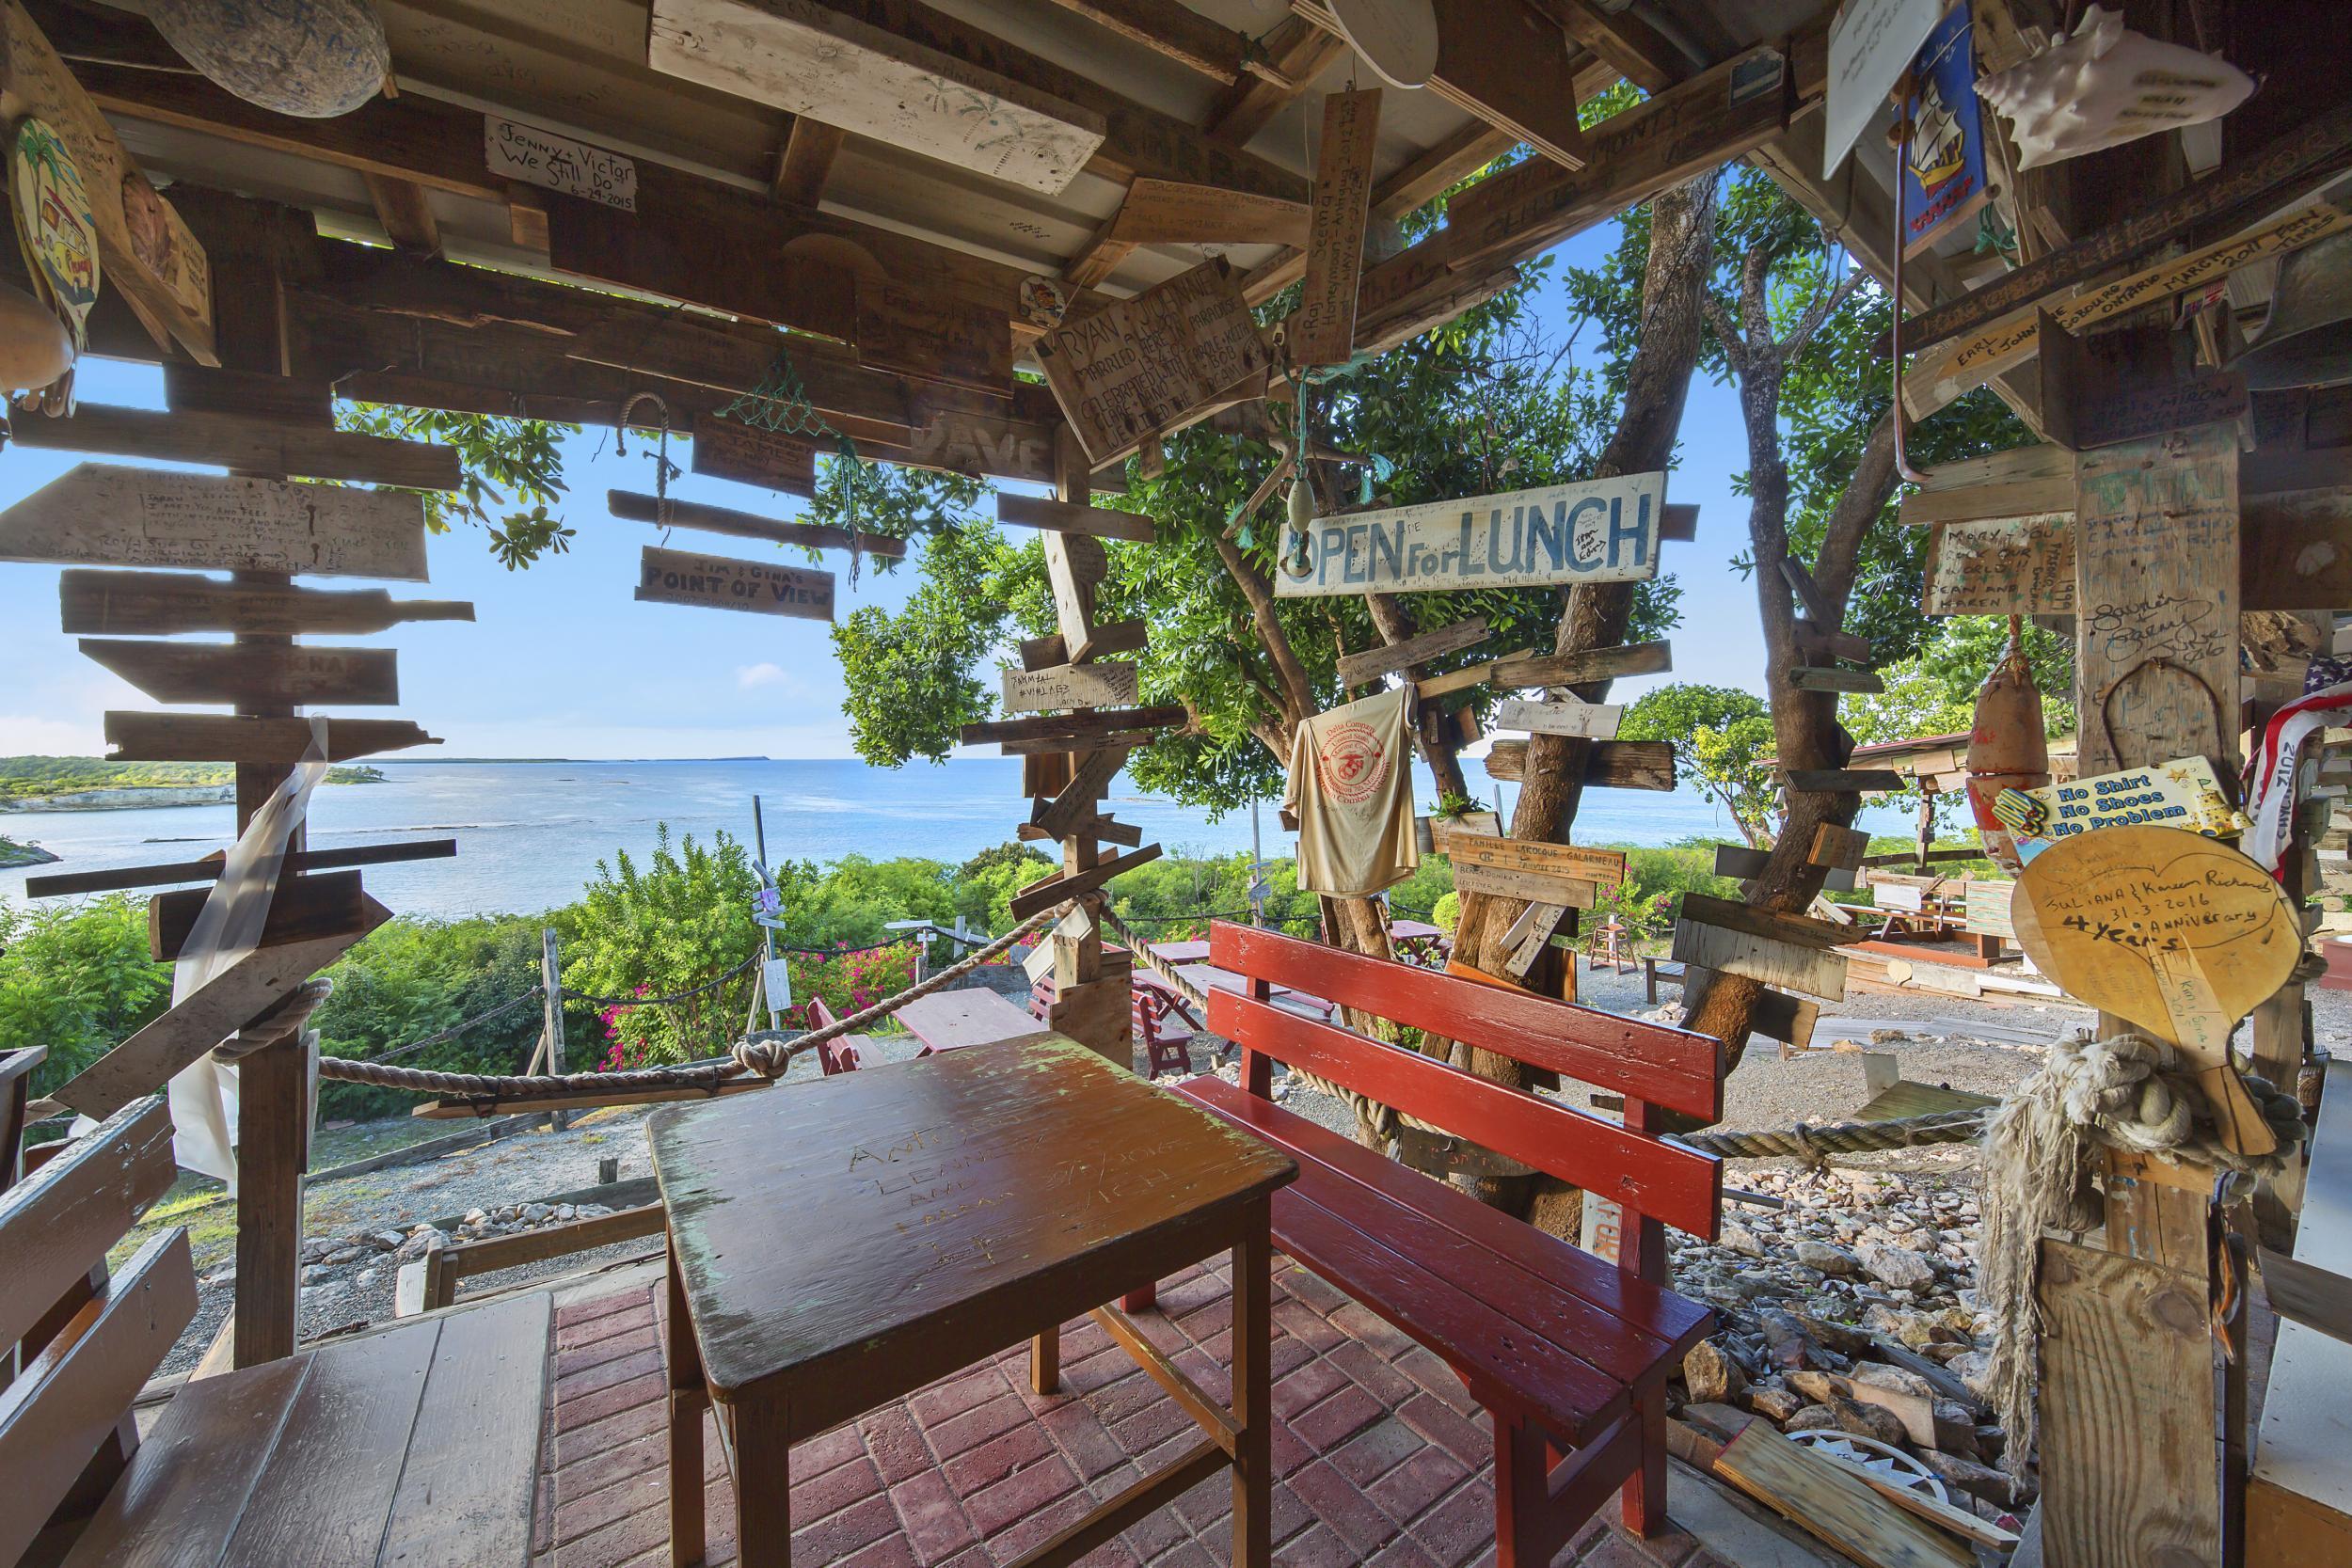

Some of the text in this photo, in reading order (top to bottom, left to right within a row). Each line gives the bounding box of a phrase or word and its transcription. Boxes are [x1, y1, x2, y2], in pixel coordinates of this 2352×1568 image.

[546, 156, 581, 186] Still
[578, 146, 633, 181] Victor
[571, 183, 633, 209] 6-29-2015
[1331, 168, 1348, 227] Antigua
[2163, 213, 2338, 292] MARCH 2011 TIMES
[1321, 240, 1342, 325] Honeymoon
[2060, 273, 2161, 329] COBOURG ONTARIO
[1058, 313, 1120, 360] RYAN
[1075, 347, 1137, 384] MARRIED
[1139, 334, 1168, 356] HERE
[1188, 296, 1242, 332] PARADISE
[1957, 337, 1998, 367] EARL
[1080, 375, 1156, 420] CELEBRATED
[1407, 541, 1460, 577] For
[1459, 492, 1652, 576] LUNCH
[646, 565, 832, 607] POINT OF VIEW
[1326, 721, 1376, 737] Delta Company
[1332, 734, 1353, 747] United
[1332, 742, 1353, 757] Marine
[1336, 793, 1371, 804] Combat
[2058, 774, 2153, 802] No Shirt
[2058, 791, 2166, 819] No Shoes
[2052, 805, 2187, 837] No Problem
[1469, 837, 1505, 850] FAMILLE
[1515, 844, 1559, 858] LAROCQUE
[2062, 914, 2090, 932] 4
